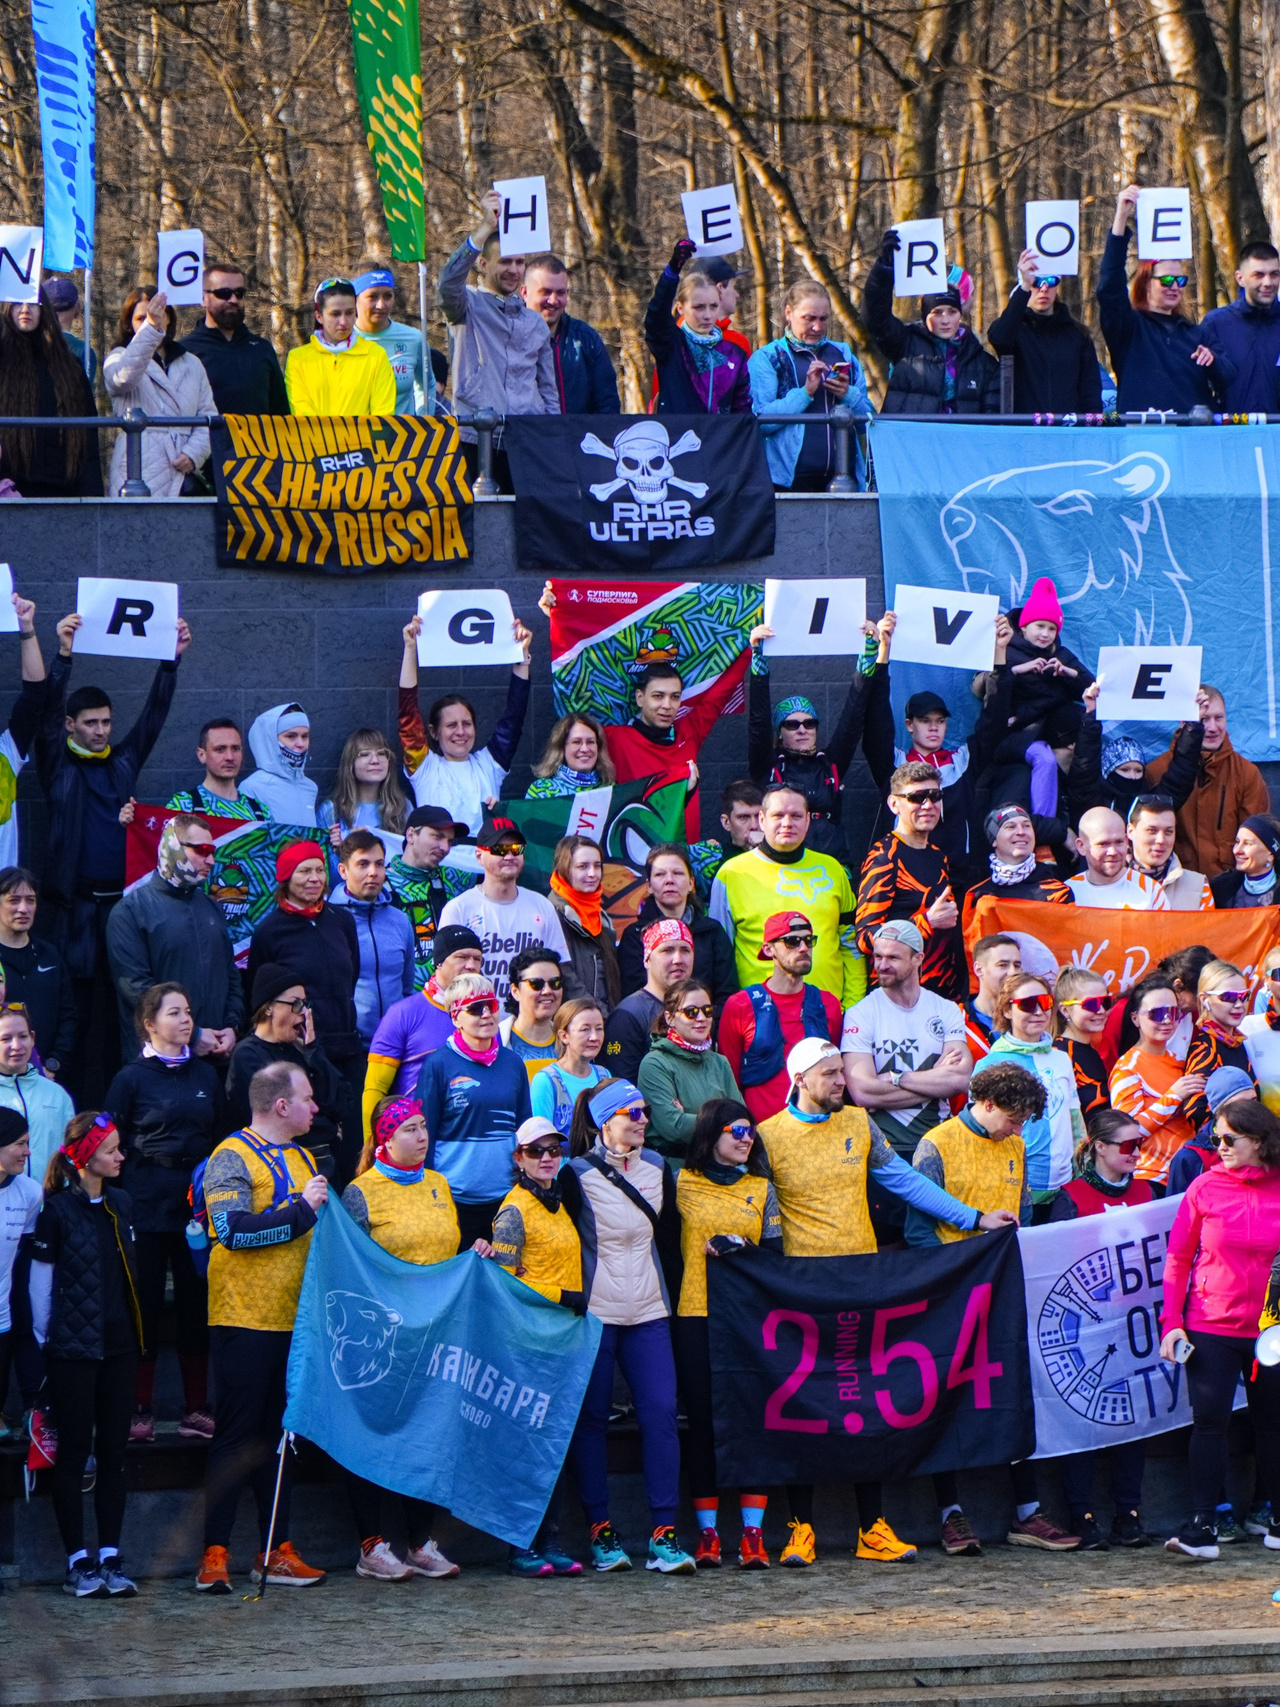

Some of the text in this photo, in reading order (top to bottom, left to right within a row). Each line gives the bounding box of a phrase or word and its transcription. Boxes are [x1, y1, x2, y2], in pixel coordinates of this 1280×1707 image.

[503, 195, 537, 234] H
[702, 204, 733, 243] E
[1151, 207, 1183, 242] E
[1035, 220, 1075, 258] O
[0, 246, 36, 285] N
[166, 250, 200, 287] G
[906, 240, 938, 278] R
[226, 414, 397, 463] RUNNING
[320, 452, 365, 472] RHR
[276, 461, 416, 511] HEROES
[589, 516, 715, 542] ULTRAS
[613, 500, 693, 522] RHR
[333, 508, 469, 566] RUSSIA
[587, 589, 638, 598] СУПЕРЛИГА
[107, 597, 154, 637] R
[448, 607, 496, 645] G
[808, 597, 830, 635] I
[932, 606, 974, 645] V
[1131, 663, 1173, 700] E
[836, 1310, 862, 1402] RUNNING
